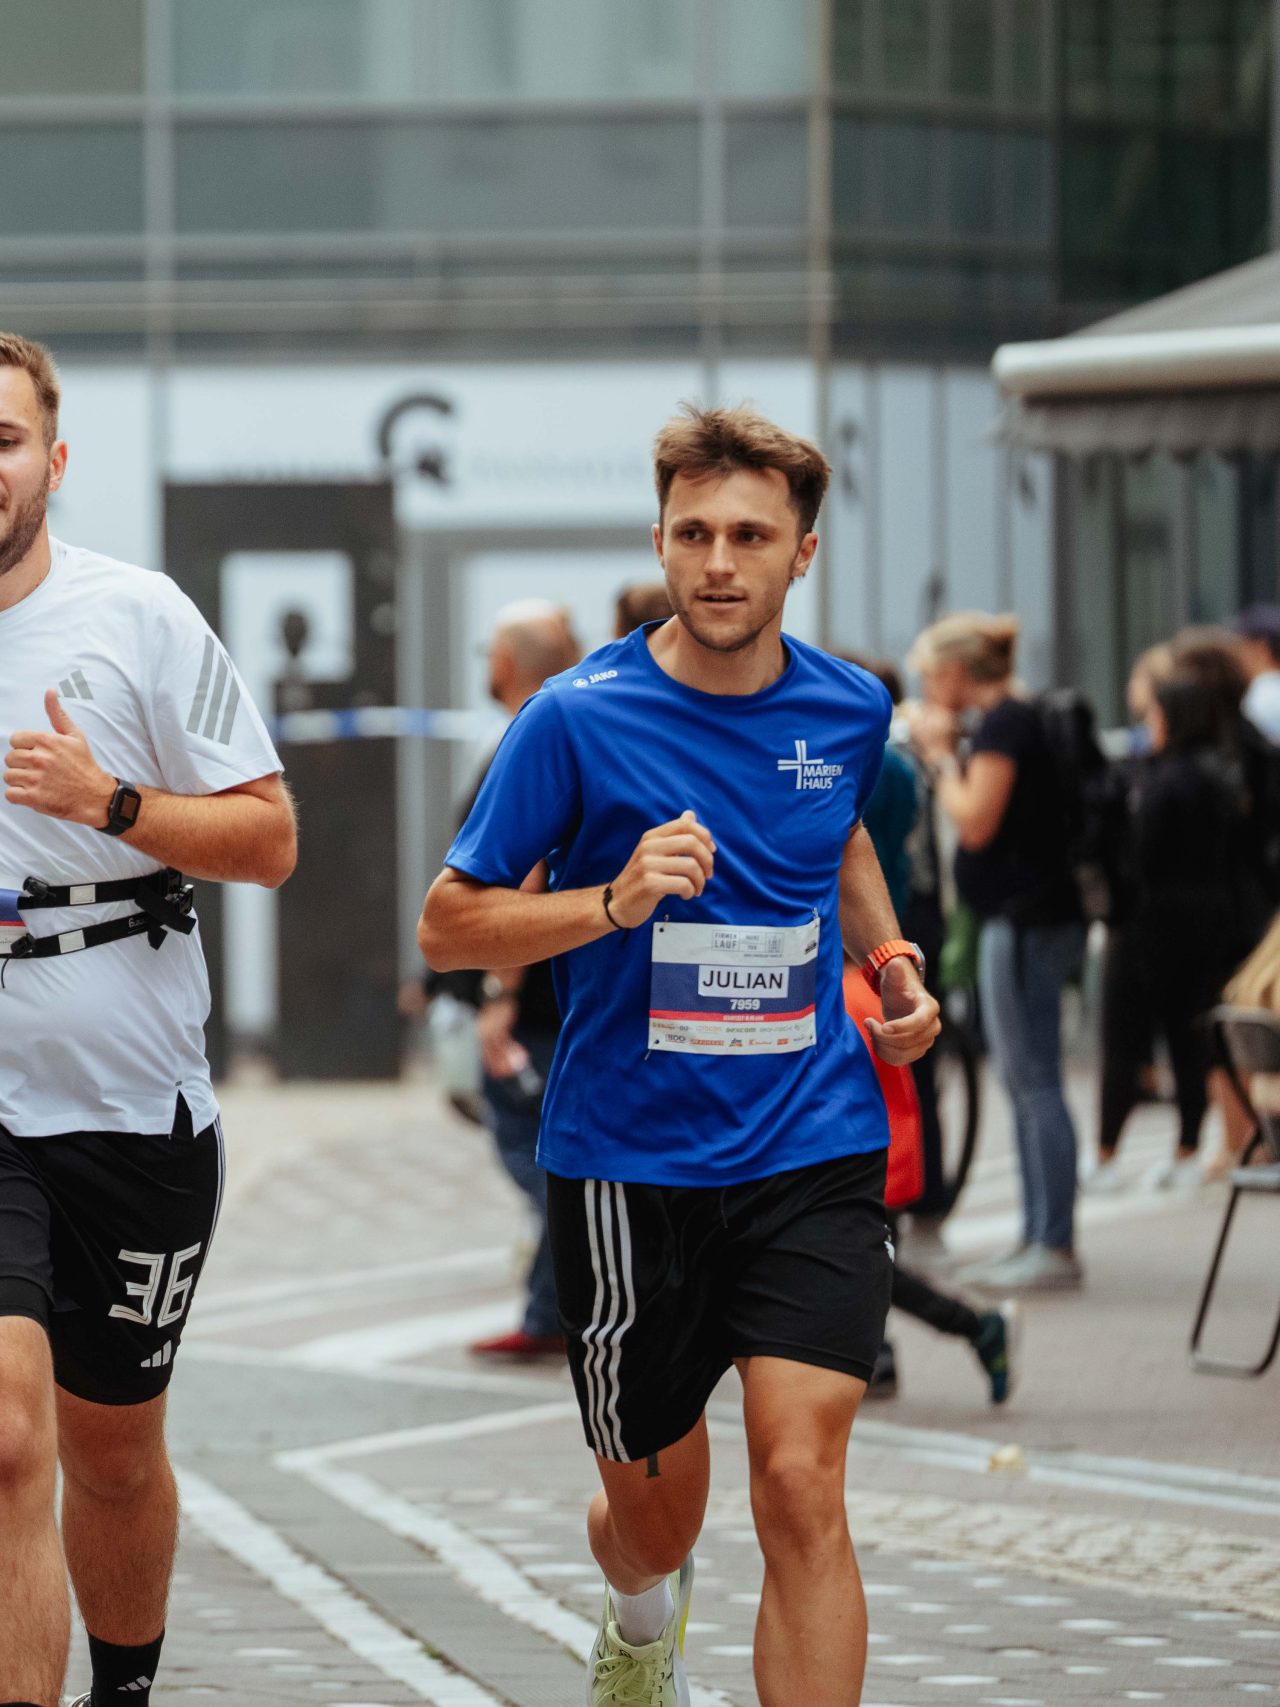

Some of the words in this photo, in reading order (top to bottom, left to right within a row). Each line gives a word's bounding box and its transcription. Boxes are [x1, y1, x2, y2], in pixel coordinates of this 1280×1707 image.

[588, 669, 618, 684] JAKO
[802, 764, 844, 777] MARIEN
[802, 777, 833, 790] HAUS
[715, 940, 737, 949] LAUF
[703, 970, 783, 989] JULIAN
[730, 998, 761, 1011] 7959
[108, 1241, 201, 1328] 36
